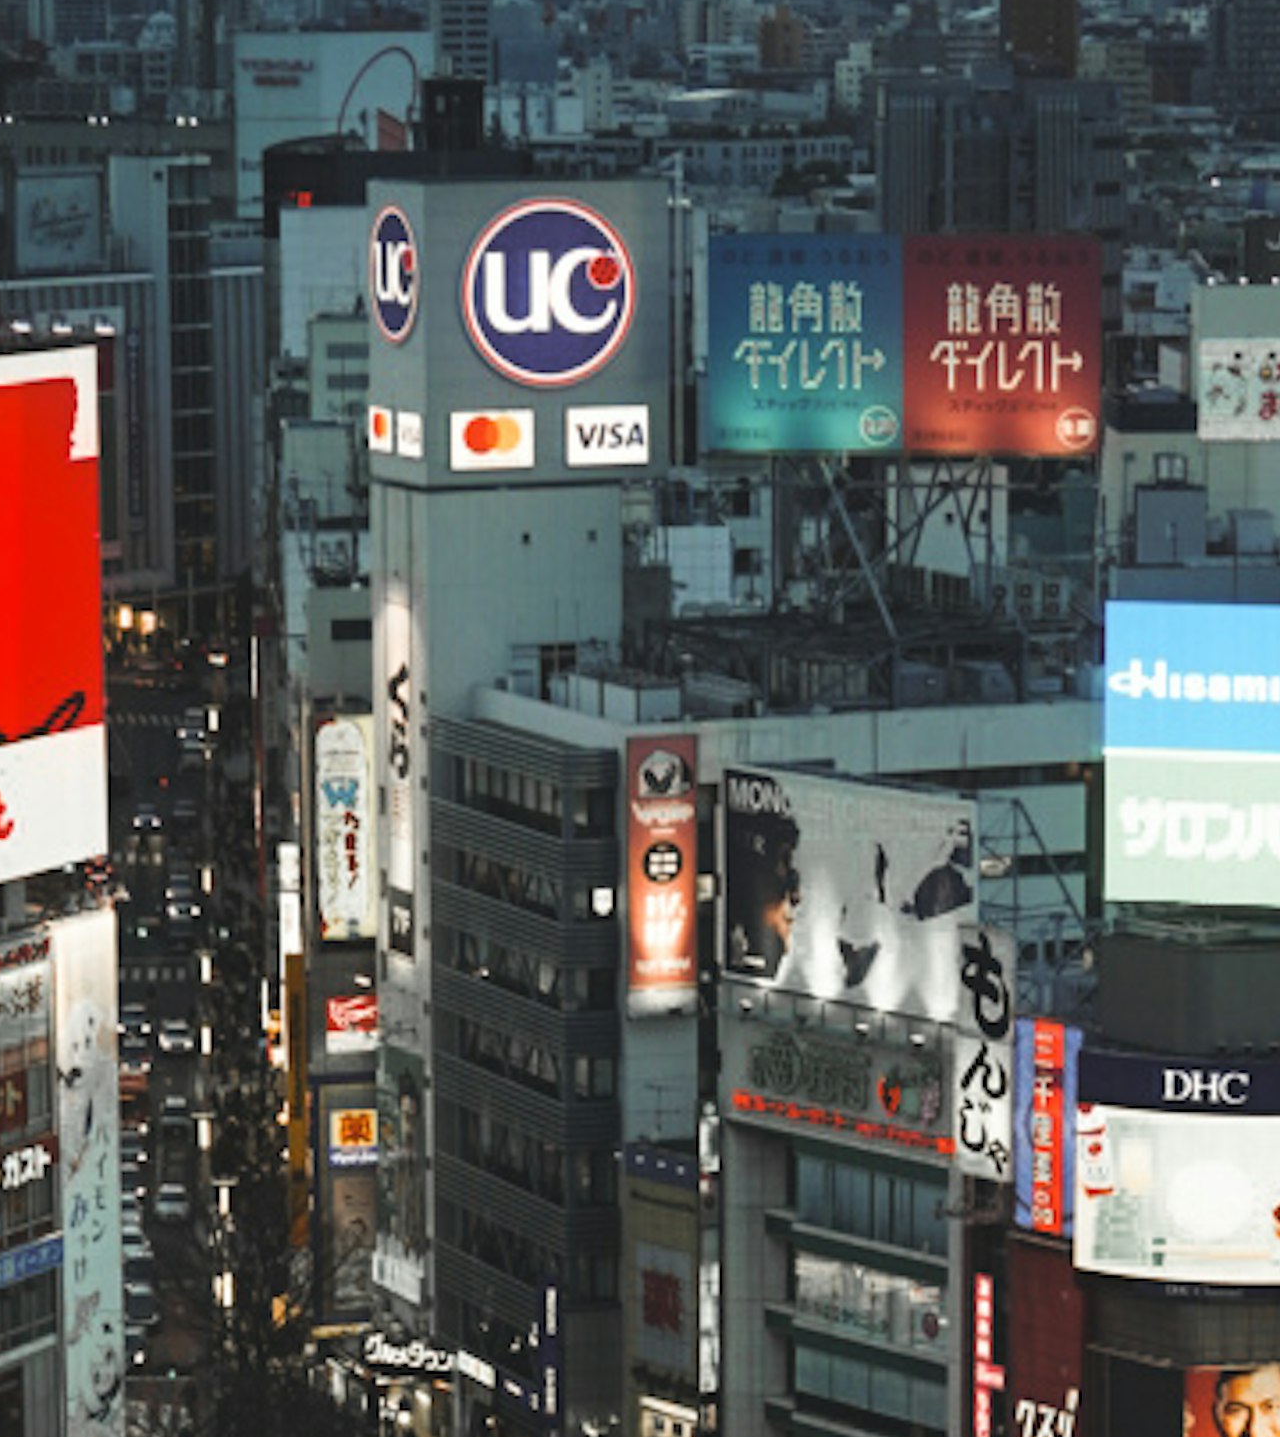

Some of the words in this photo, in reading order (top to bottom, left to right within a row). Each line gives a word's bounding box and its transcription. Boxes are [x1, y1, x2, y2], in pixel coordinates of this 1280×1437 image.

[483, 247, 619, 334] UC
[749, 281, 863, 334] 龍角散
[946, 282, 1062, 335] 龍角散
[733, 338, 886, 390] ダイレクト
[929, 340, 1083, 392] ダイレクト
[576, 423, 644, 449] VISA
[1163, 1069, 1250, 1104] DHC
[2, 1145, 52, 1190] ガスト
